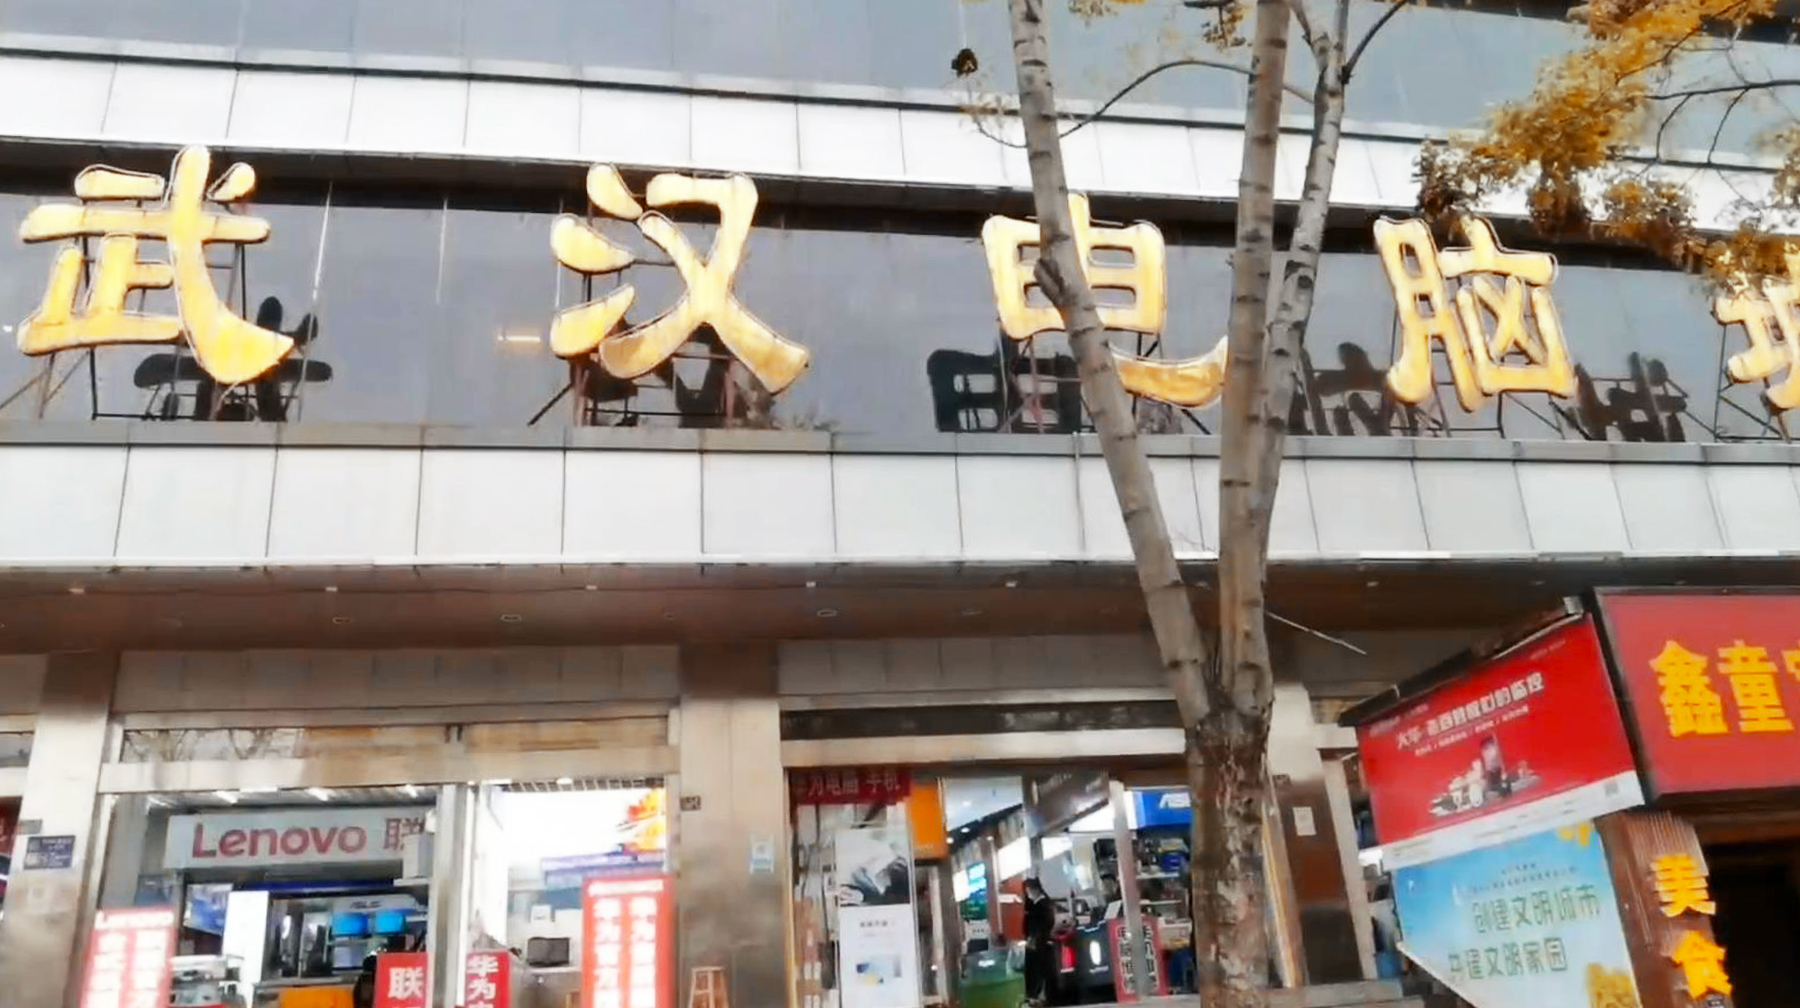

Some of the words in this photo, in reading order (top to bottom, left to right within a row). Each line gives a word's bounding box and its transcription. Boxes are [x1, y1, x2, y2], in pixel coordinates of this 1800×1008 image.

[1649, 640, 1800, 737] 鑫童
[192, 822, 367, 858] Lenovo
[1473, 884, 1600, 933] 创建文明城市
[1651, 853, 1733, 1000] 美食
[387, 966, 424, 1008] 联
